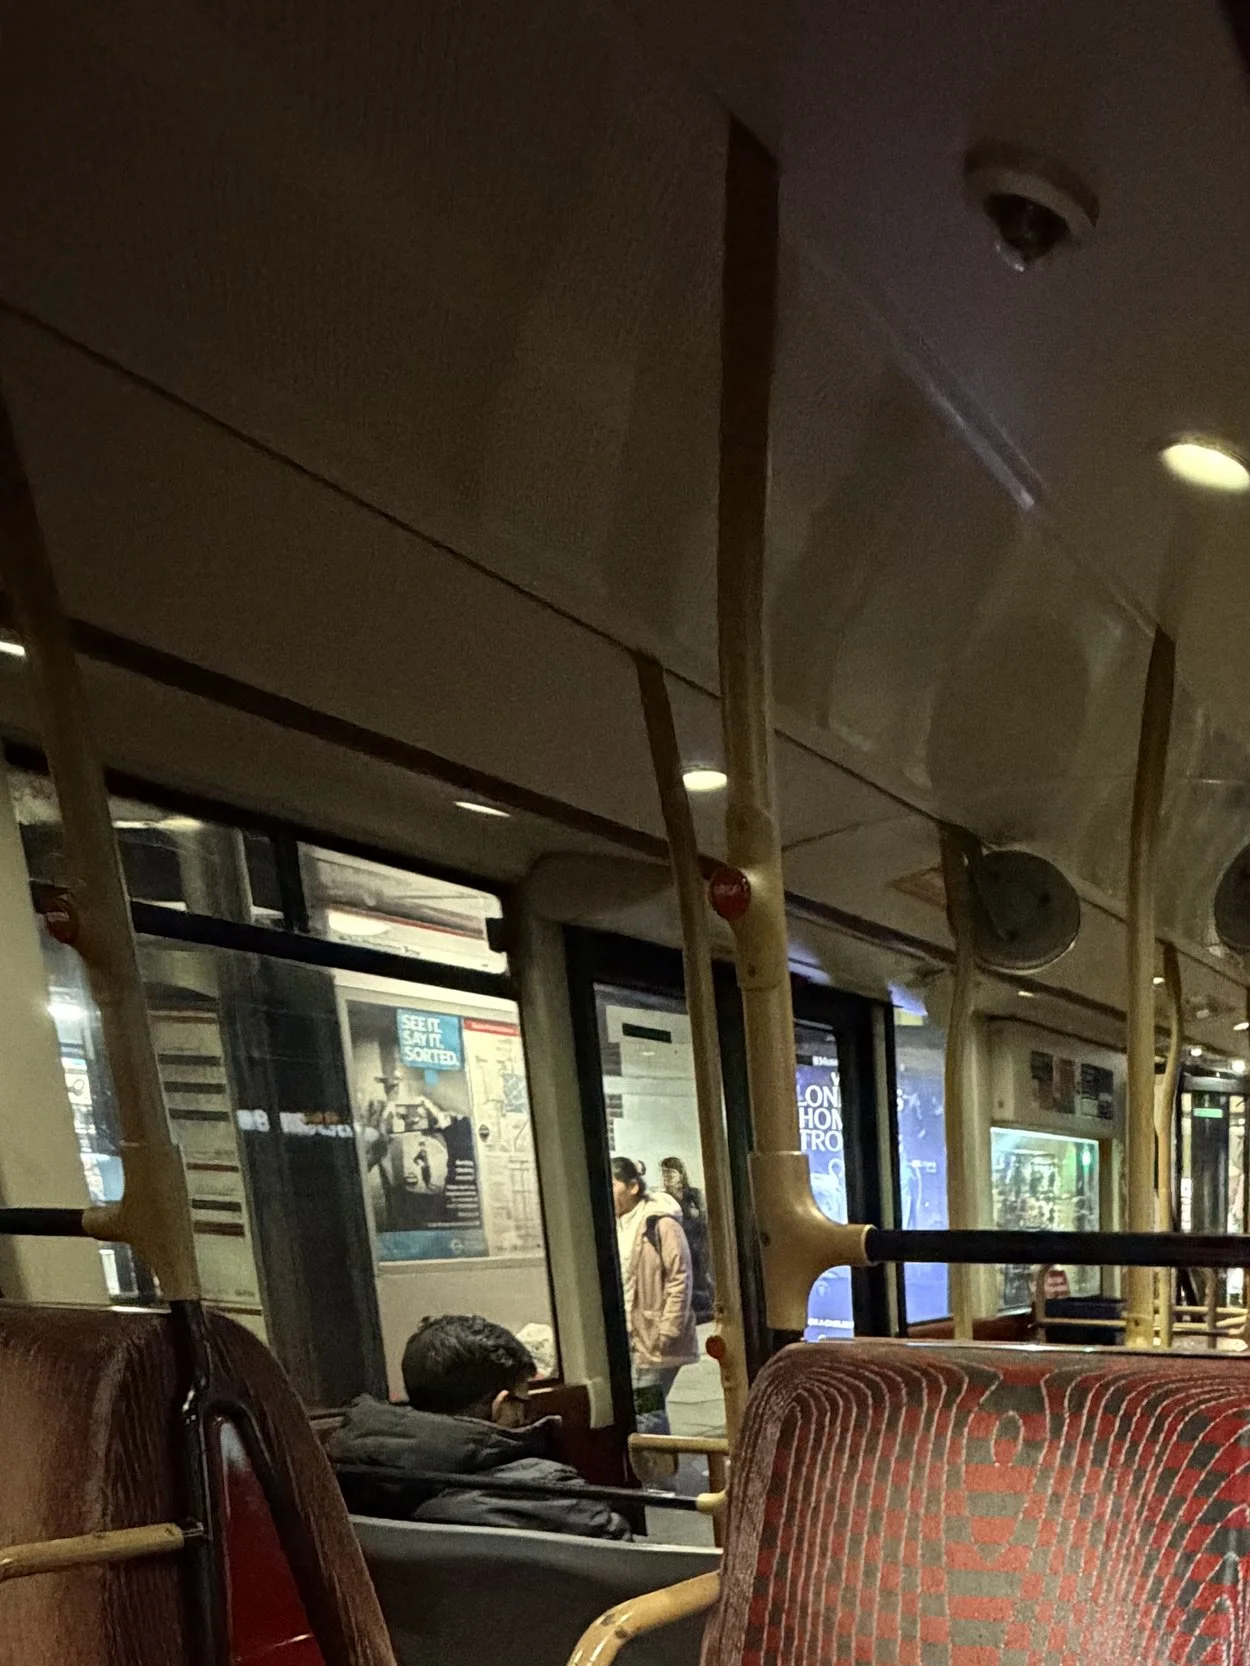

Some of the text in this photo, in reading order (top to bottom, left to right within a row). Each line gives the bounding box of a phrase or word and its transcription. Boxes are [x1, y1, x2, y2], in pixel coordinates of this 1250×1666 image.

[402, 1014, 426, 1031] SEE
[402, 1030, 427, 1047] SAY
[403, 1046, 461, 1067] SORTED.
